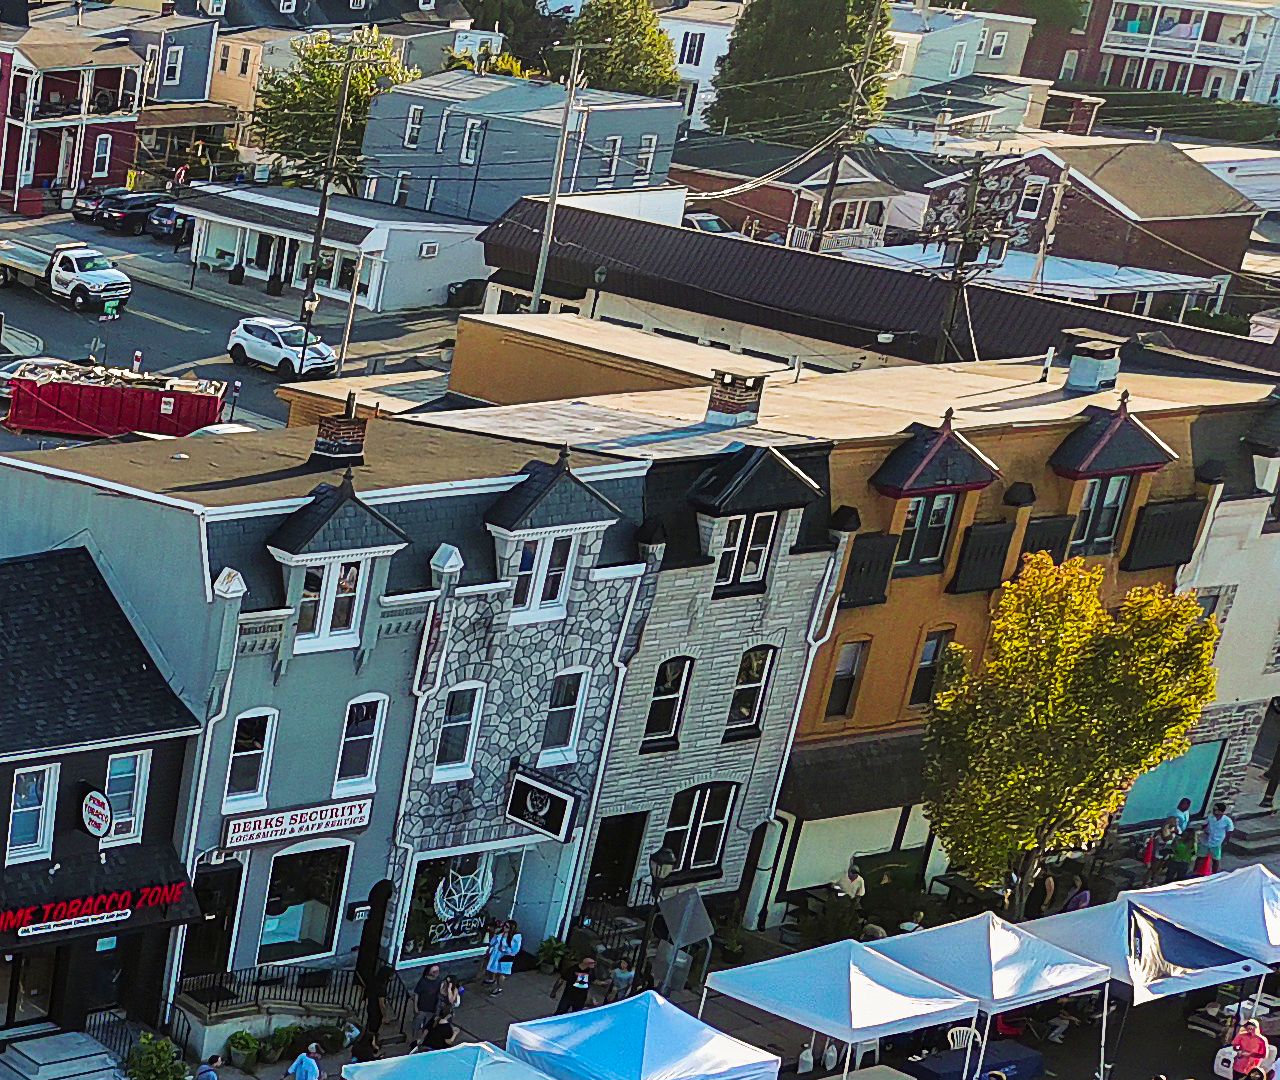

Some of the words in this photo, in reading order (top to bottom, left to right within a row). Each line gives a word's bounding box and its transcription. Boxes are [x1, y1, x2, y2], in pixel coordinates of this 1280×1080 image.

[230, 828, 287, 845] LOCKSMITH
[298, 822, 323, 834] SAFE
[324, 815, 366, 829] SERVICE
[232, 816, 284, 834] BERKS
[289, 803, 367, 825] SECURITY
[43, 891, 132, 921] TOBACCO
[137, 881, 187, 910] ZONE
